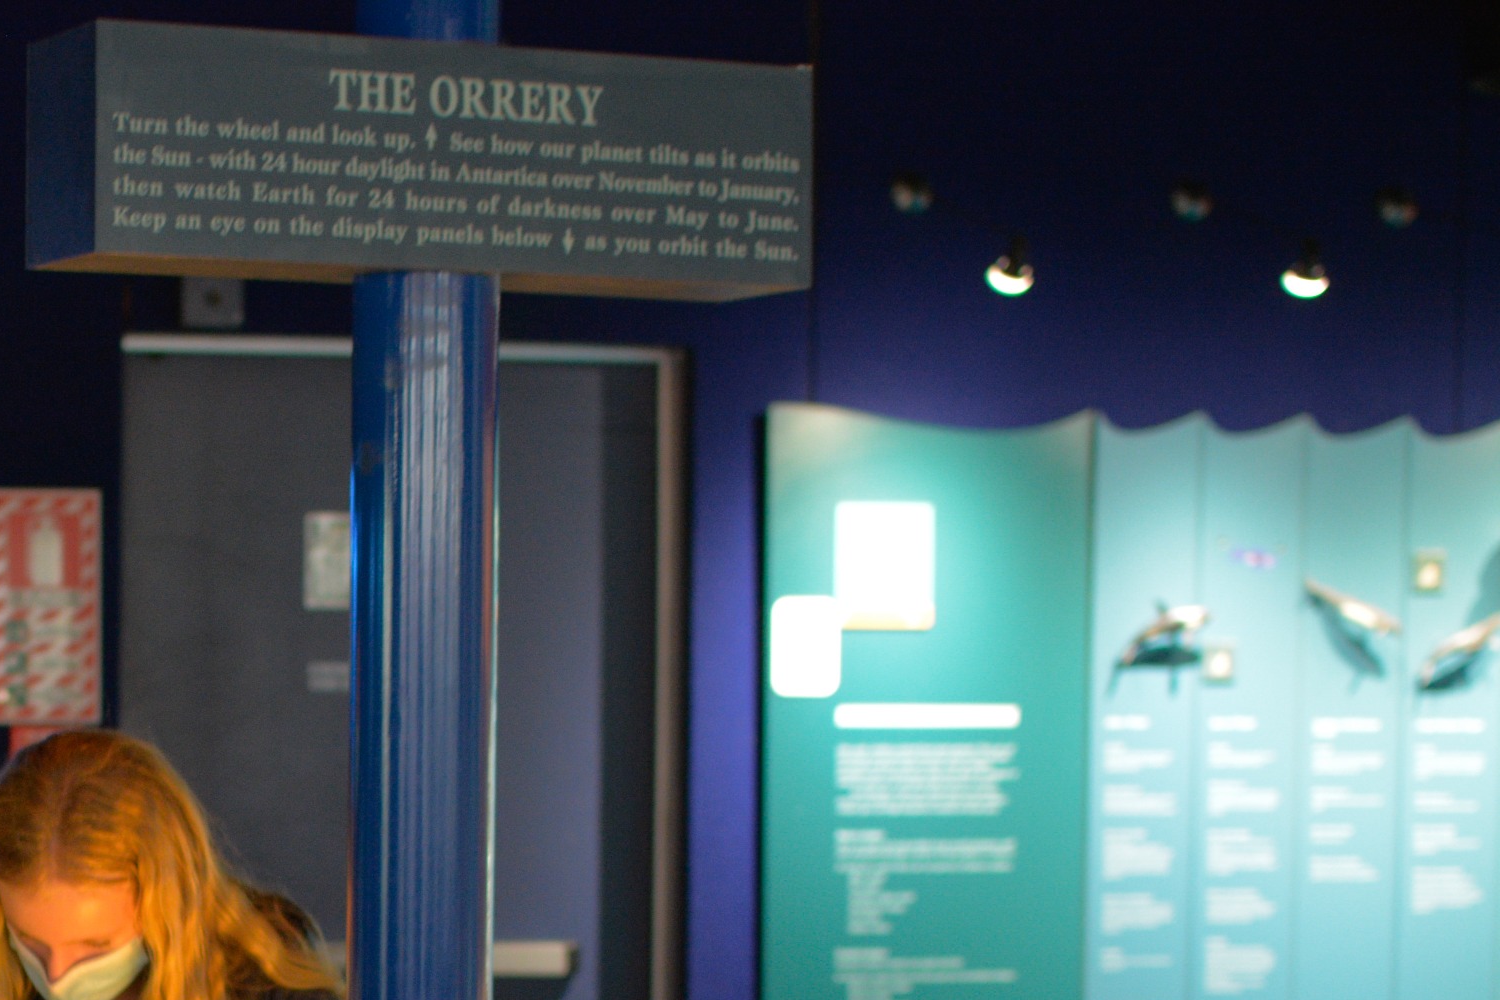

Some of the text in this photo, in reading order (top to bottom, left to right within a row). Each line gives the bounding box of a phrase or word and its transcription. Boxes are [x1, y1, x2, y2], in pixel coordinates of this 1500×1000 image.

[329, 68, 603, 126] THE ORRERY
[112, 111, 168, 135] Turn
[174, 114, 209, 137] the
[216, 117, 279, 141] wheel
[286, 122, 325, 143] and
[332, 124, 377, 147] look
[450, 131, 484, 153] See
[490, 132, 534, 156] how
[540, 141, 572, 159] our
[580, 141, 643, 165] planet
[650, 143, 689, 167] tilts
[695, 150, 716, 168] as
[721, 147, 737, 169] it
[741, 150, 800, 173] orbits
[112, 142, 146, 165] the
[151, 145, 191, 167] Sun
[209, 147, 257, 171] with
[261, 151, 287, 172] 24
[292, 152, 341, 175] hour
[345, 155, 425, 184] daylight
[429, 160, 451, 182] in
[455, 161, 548, 189] Antartica
[552, 172, 594, 190] over
[599, 170, 695, 196] November
[699, 178, 718, 197] to
[112, 173, 800, 234] then watch Earth for 24 hours of darkness over May to June.
[111, 205, 799, 262] Keep an eye on the display panels below as you orbit the Sun.
